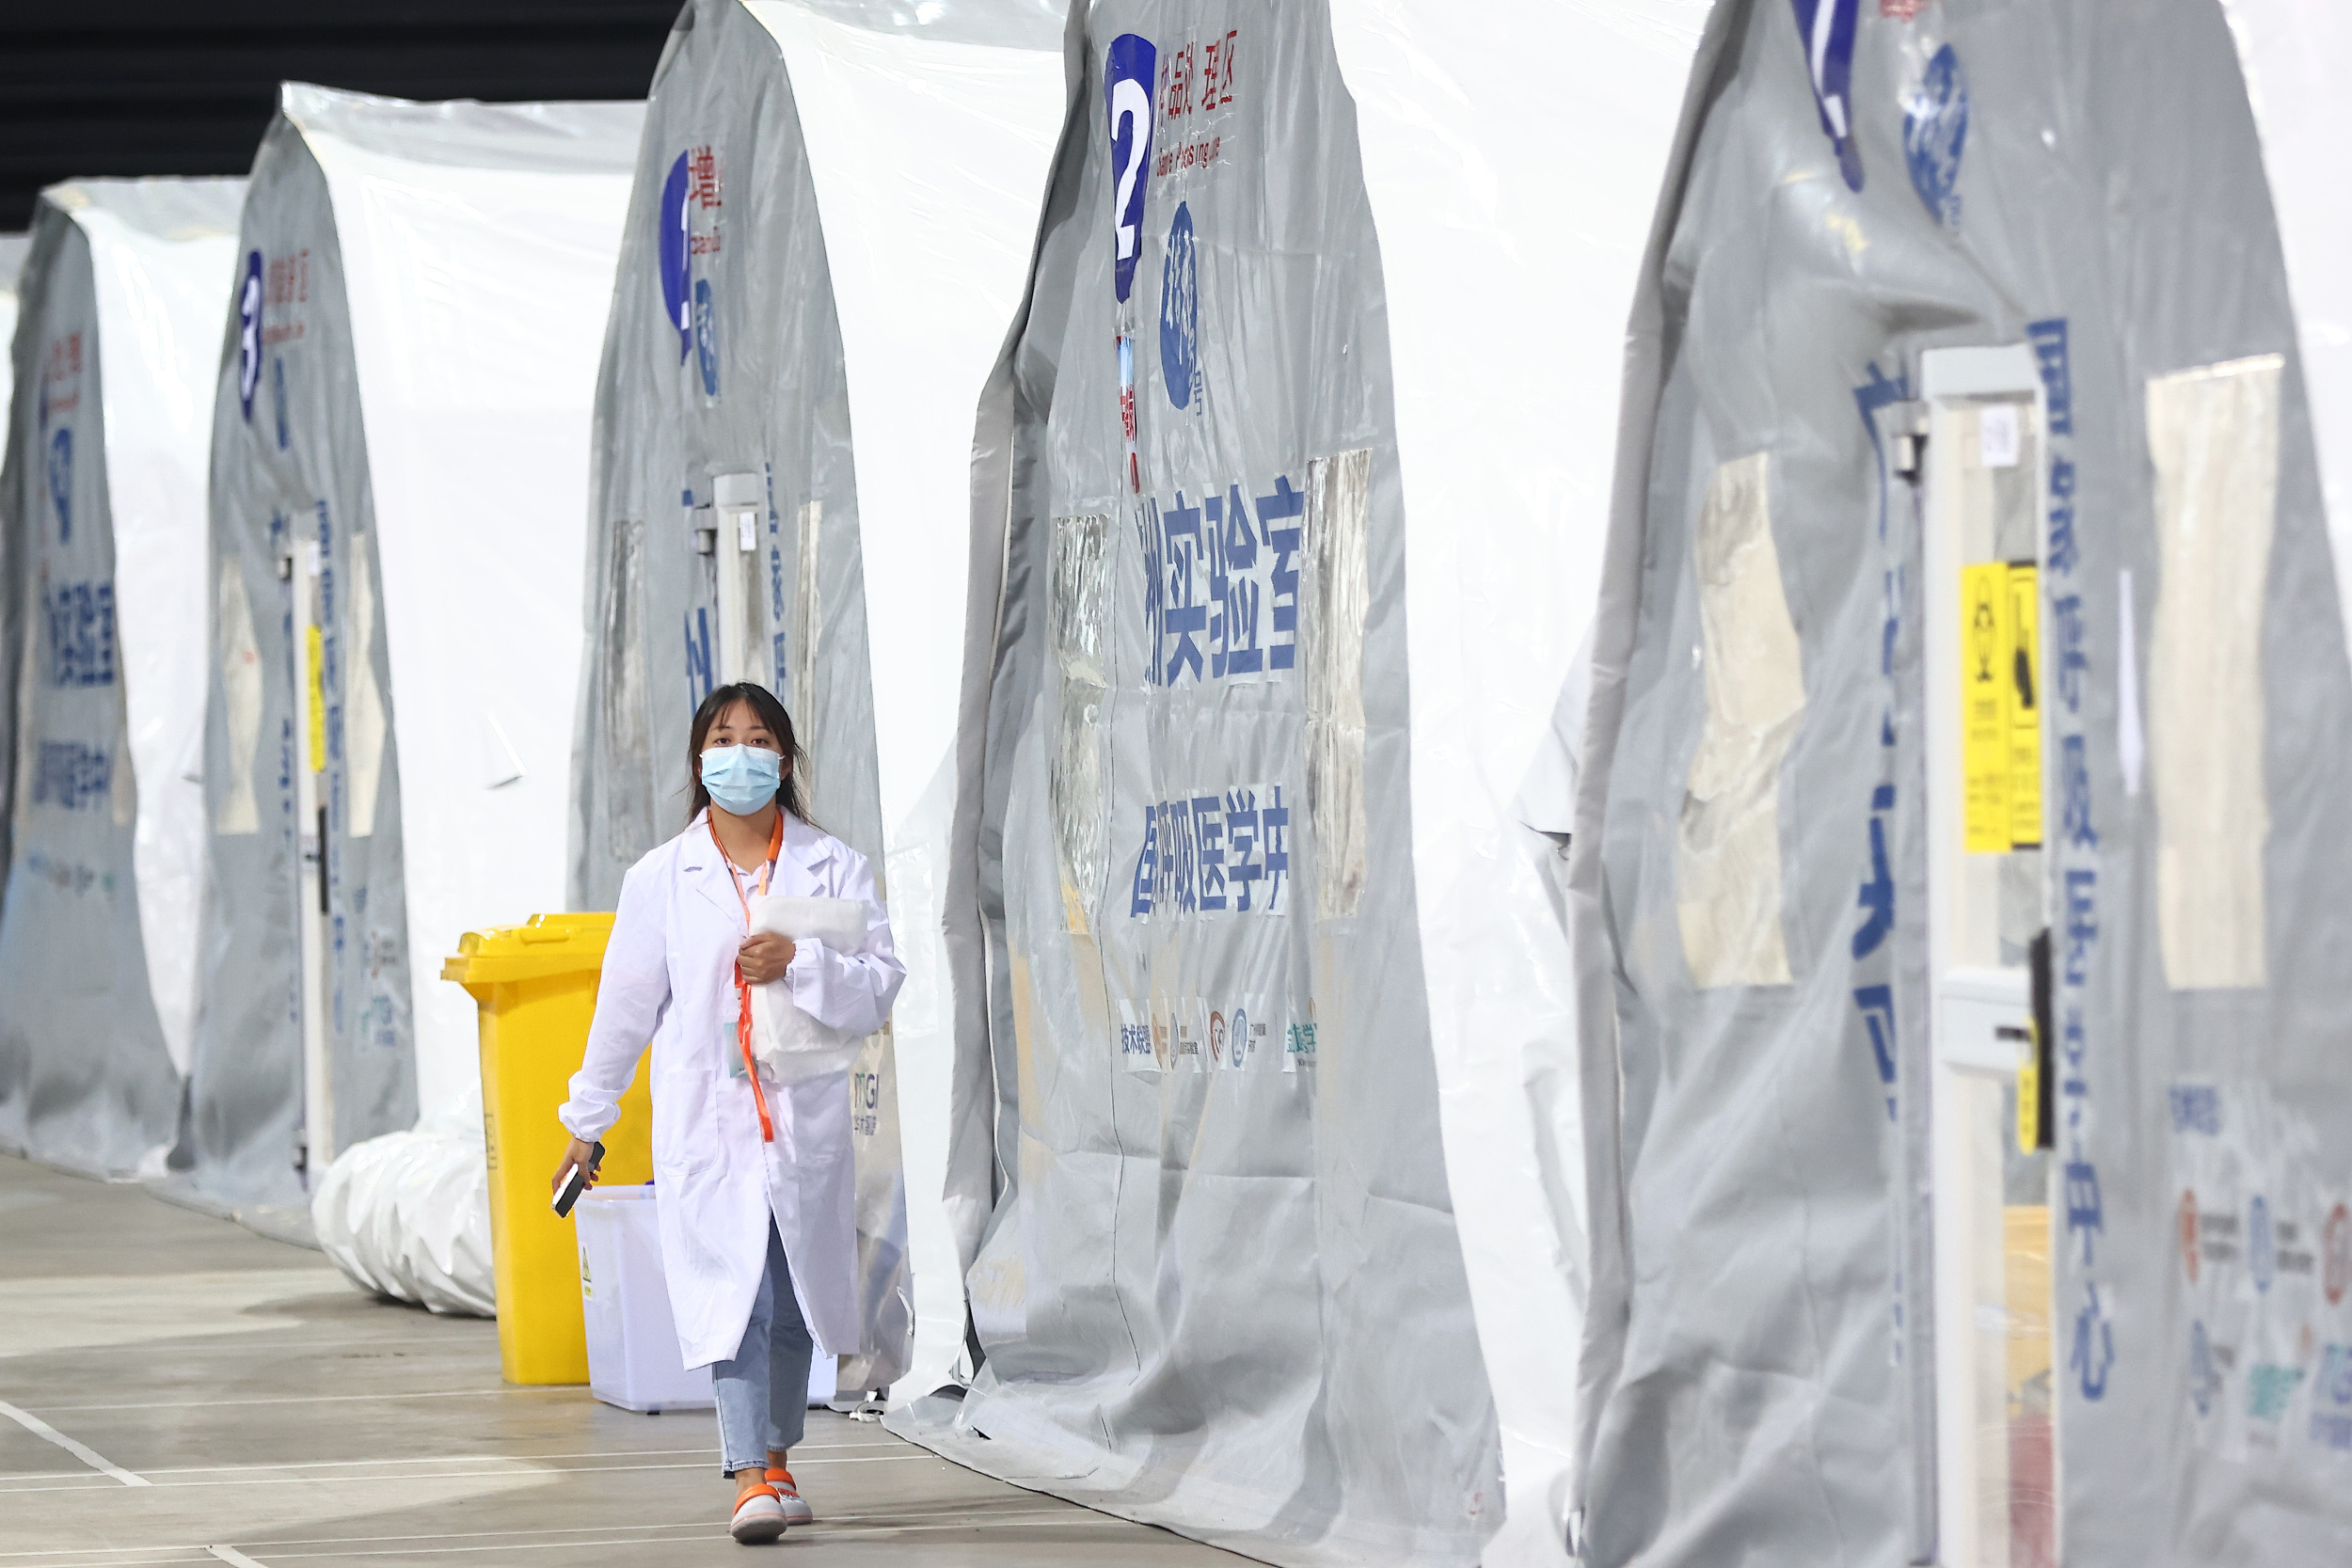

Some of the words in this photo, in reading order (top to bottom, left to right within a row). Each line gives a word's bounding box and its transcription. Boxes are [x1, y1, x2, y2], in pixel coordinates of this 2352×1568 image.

[1111, 79, 1150, 261] 2
[1134, 475, 1305, 688] 实验室
